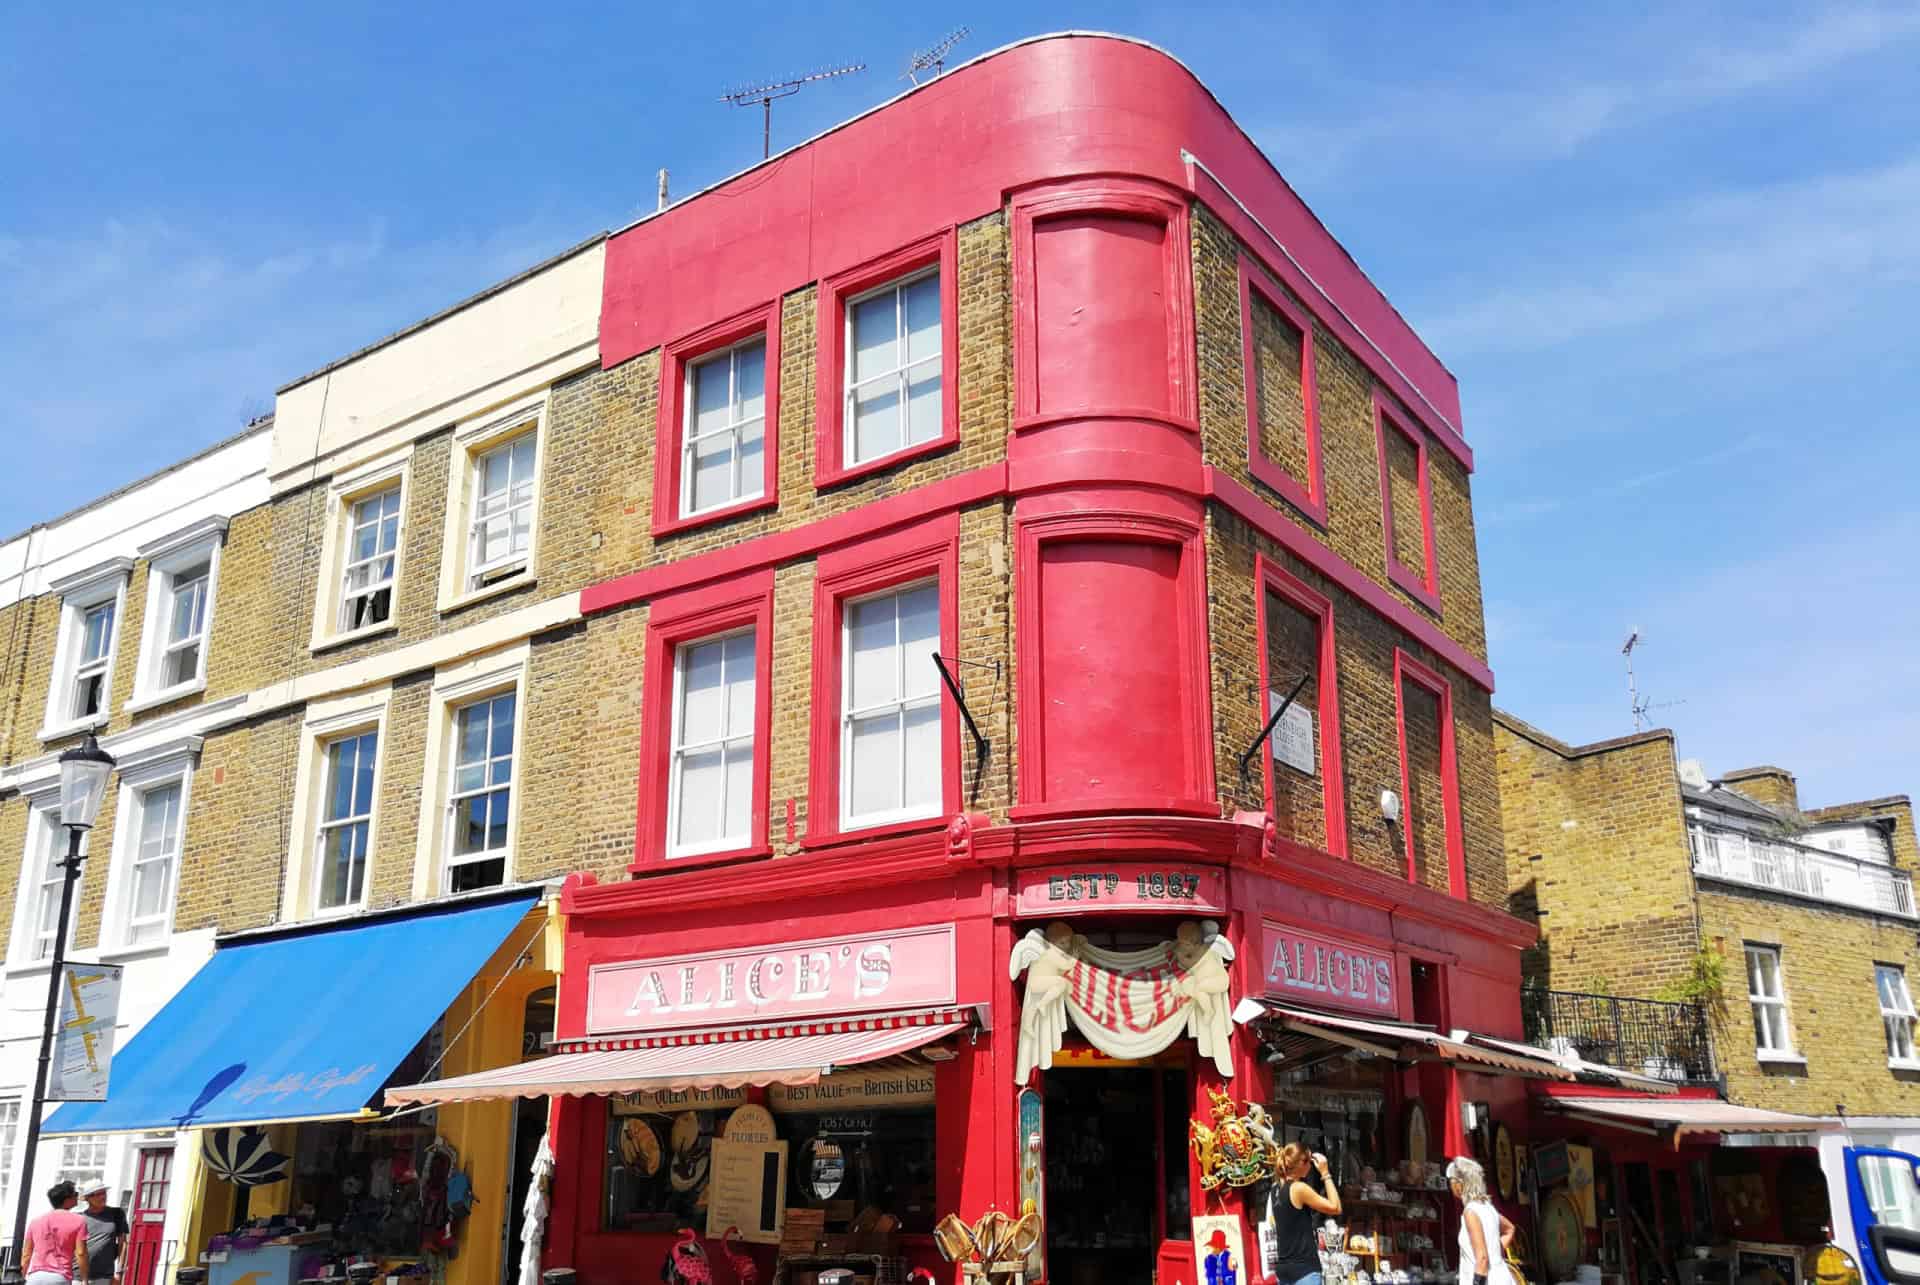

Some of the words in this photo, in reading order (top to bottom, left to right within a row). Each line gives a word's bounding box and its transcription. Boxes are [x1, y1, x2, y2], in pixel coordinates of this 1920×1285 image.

[1136, 871, 1201, 900] 1887
[625, 943, 892, 1016] ALICE'S
[1267, 938, 1391, 1004] ALICE'S
[786, 1085, 810, 1100] BEST
[814, 1083, 844, 1099] VALUE
[864, 1078, 903, 1097] BRITISH
[905, 1074, 933, 1094] ISLES
